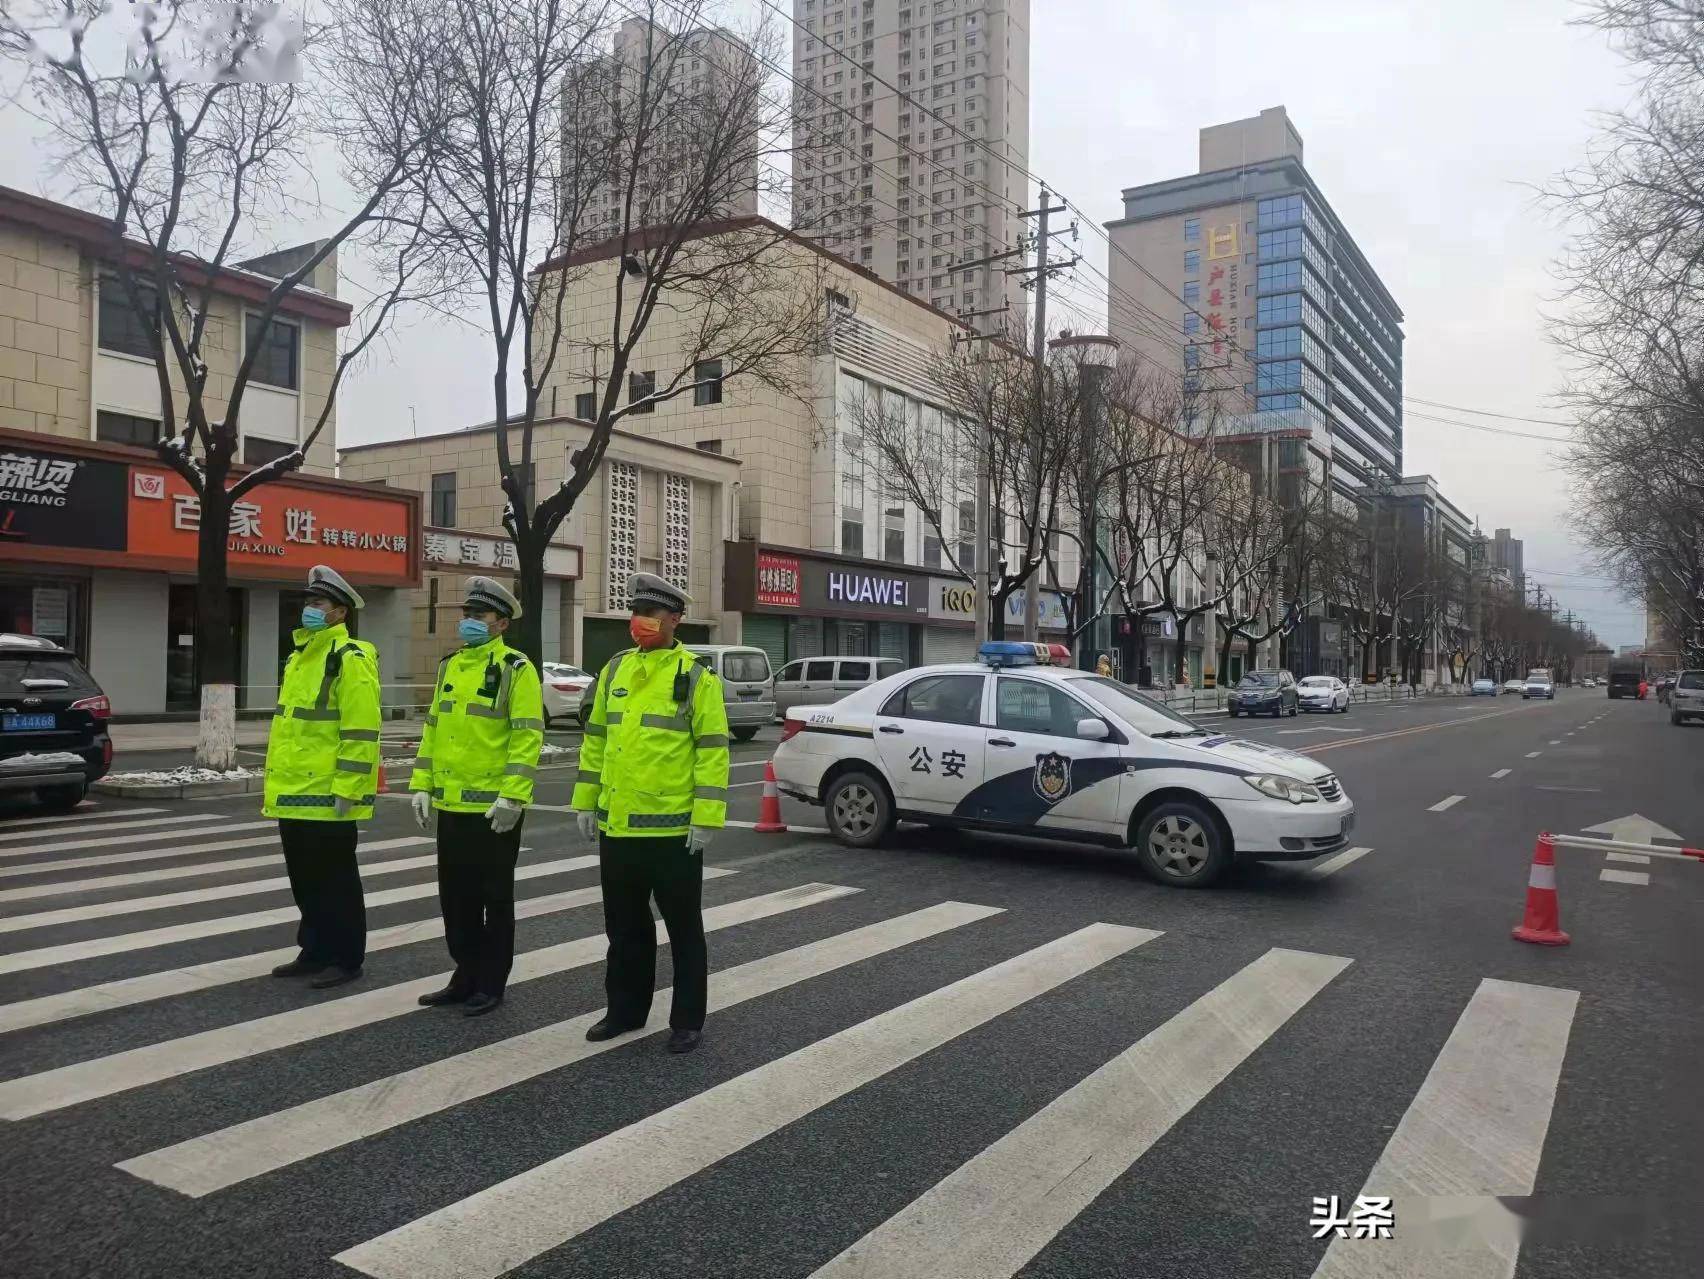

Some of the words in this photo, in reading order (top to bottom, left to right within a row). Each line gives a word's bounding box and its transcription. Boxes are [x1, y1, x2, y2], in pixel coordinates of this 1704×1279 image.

[173, 493, 317, 545] 百家姓
[322, 527, 407, 553] 转转小火锅
[424, 534, 549, 573] 秦宝温
[829, 572, 909, 607] HUAWEI
[941, 586, 976, 613] iQO
[1007, 591, 1046, 618] vio
[809, 713, 835, 724] A2214
[908, 746, 966, 779] 公安
